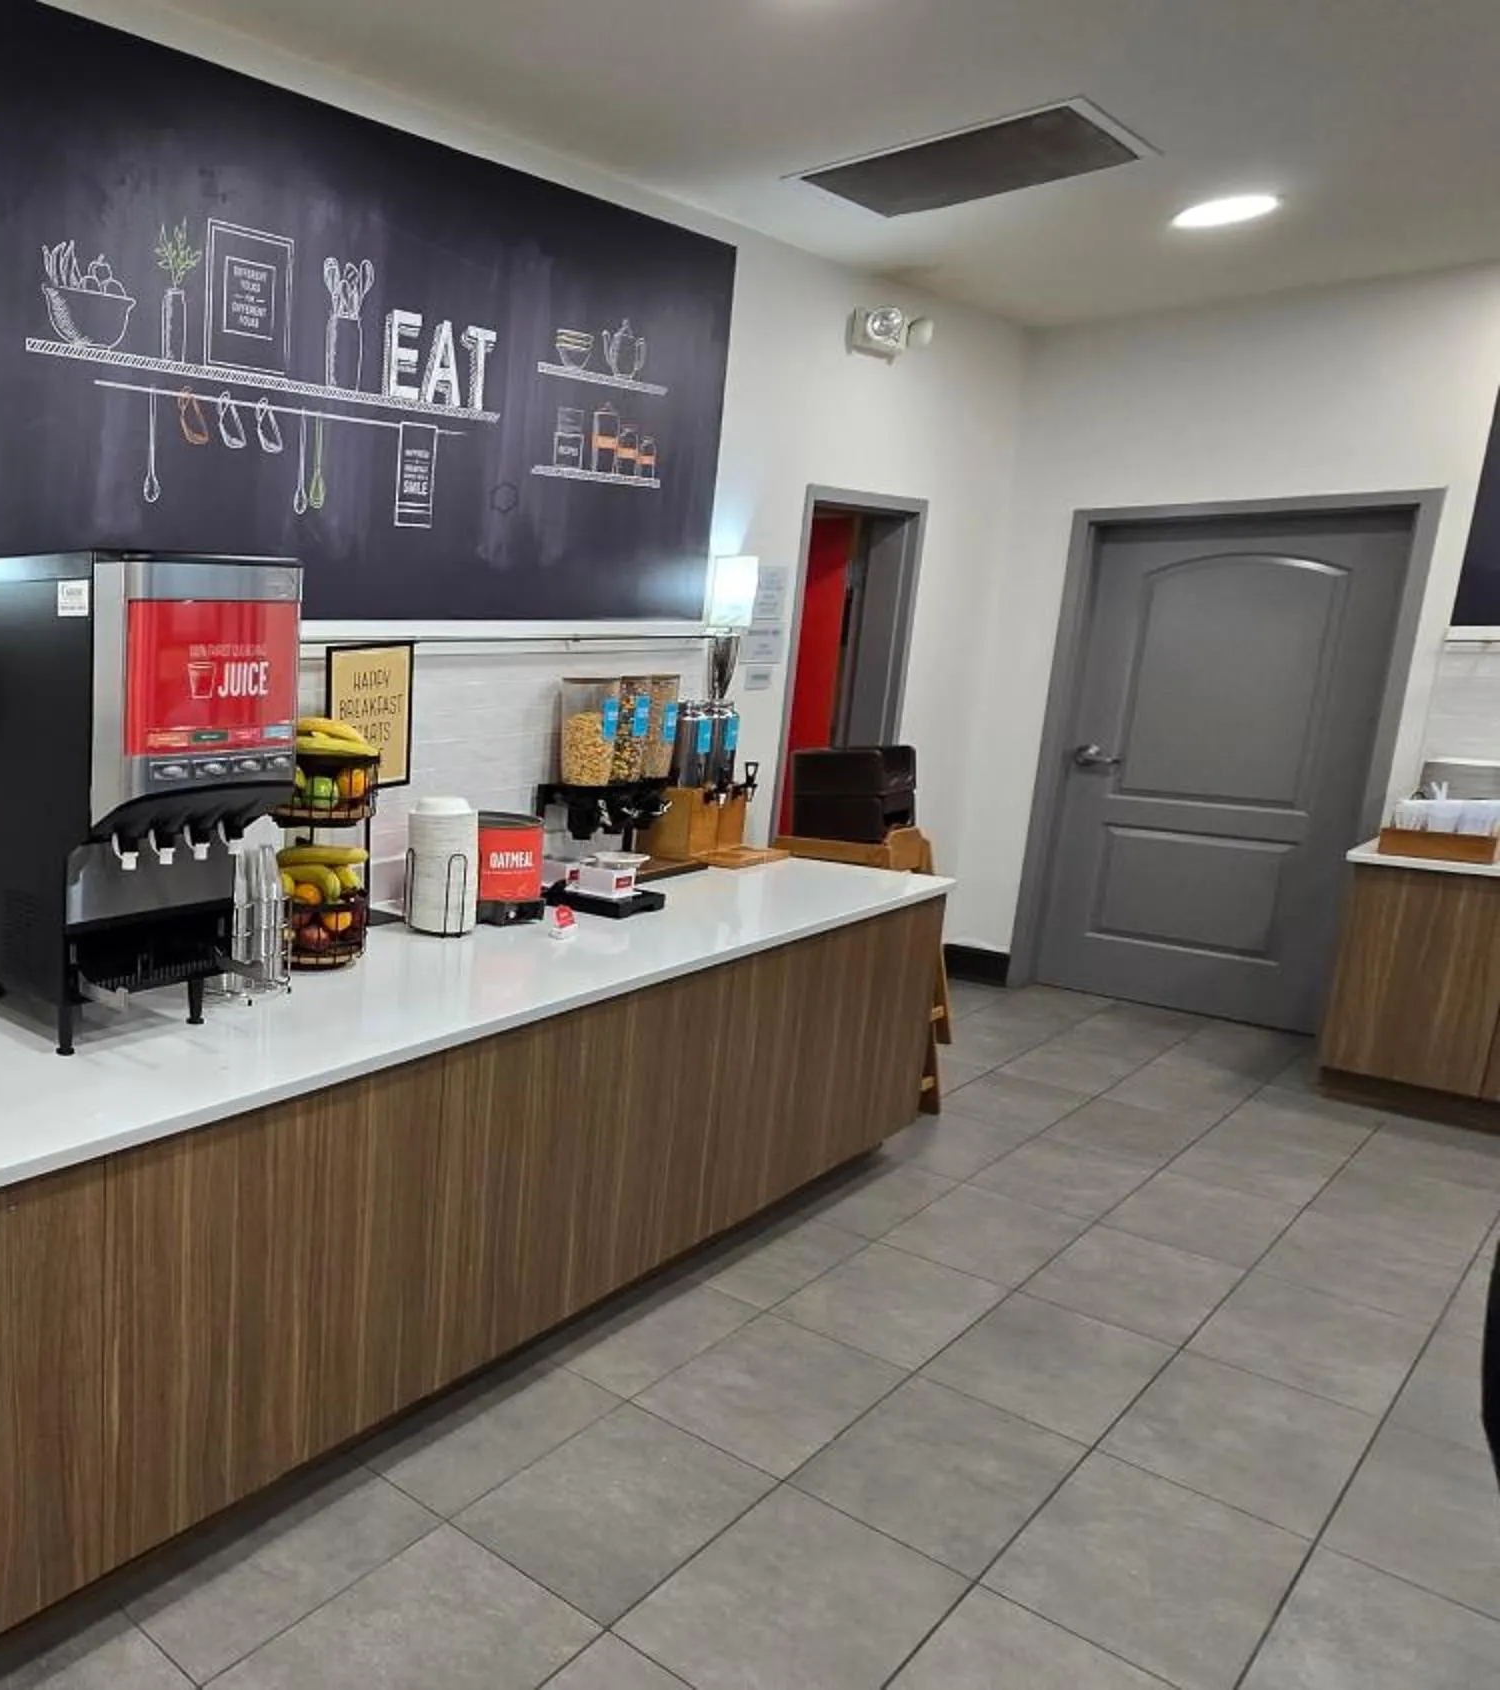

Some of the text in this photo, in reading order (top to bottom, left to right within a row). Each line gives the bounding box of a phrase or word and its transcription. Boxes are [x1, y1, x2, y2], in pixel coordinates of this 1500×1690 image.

[381, 308, 497, 411] EAT
[403, 480, 429, 495] SMILE
[217, 661, 269, 699] JUICE
[353, 667, 392, 692] HAPPY
[339, 693, 404, 720] BREAKFAST
[489, 850, 533, 869] OATMEAL
